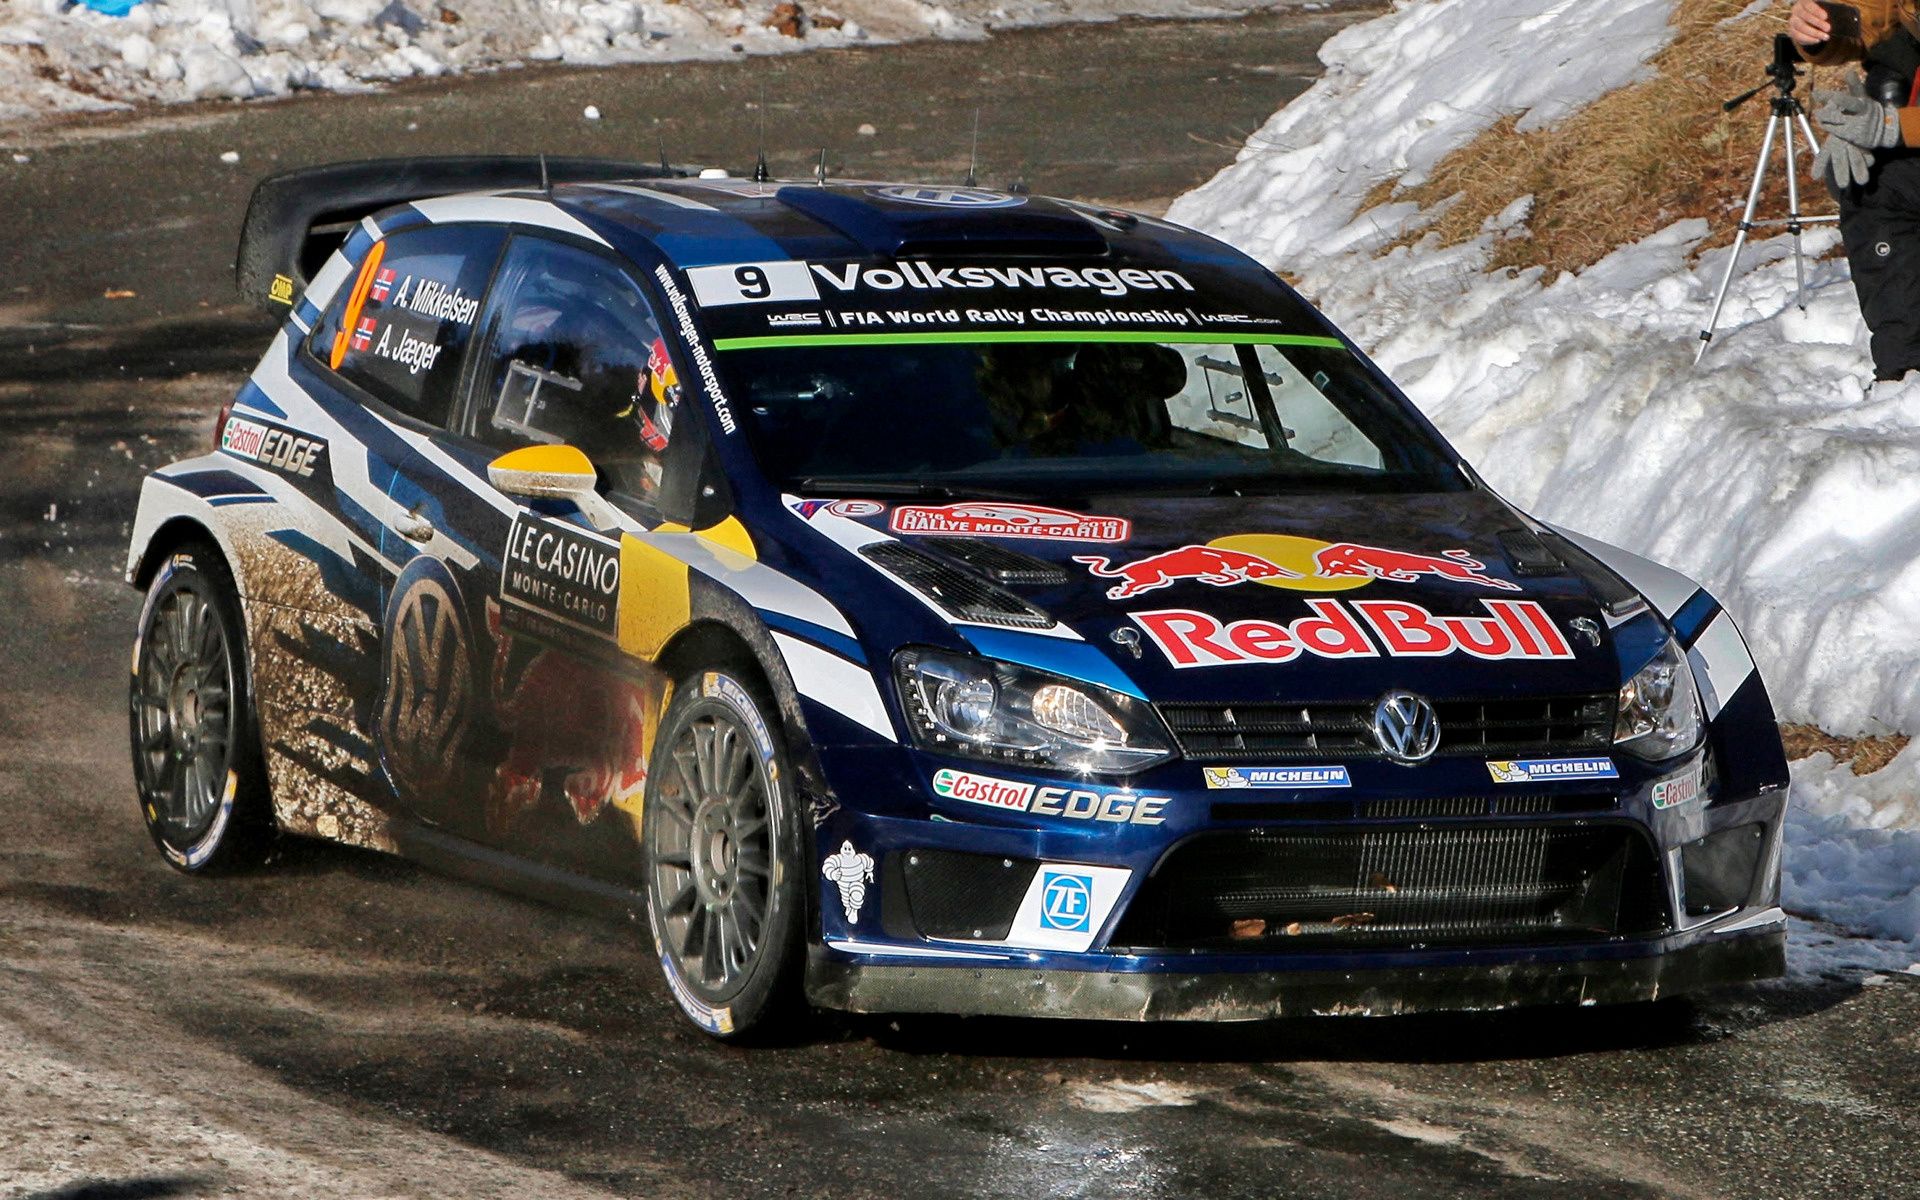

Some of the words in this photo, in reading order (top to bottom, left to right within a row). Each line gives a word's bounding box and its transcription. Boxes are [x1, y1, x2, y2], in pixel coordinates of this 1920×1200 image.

[330, 240, 386, 371] 9
[392, 275, 412, 308] A.
[410, 278, 479, 325] Mikkelsen
[733, 266, 771, 299] 9
[810, 262, 1195, 296] Volkswagen
[840, 311, 885, 325] FIA
[886, 310, 961, 324] World
[967, 309, 1024, 323] Rally
[1030, 308, 1189, 326] Championship
[374, 323, 392, 358] A.
[392, 328, 442, 375] Jæger
[654, 263, 737, 436] www.volkswagen-motorsport.com
[229, 421, 264, 457] Castrol
[258, 429, 325, 477] EDGE
[902, 514, 970, 531] RALLYE
[975, 523, 1118, 539] MONTE-CARLO
[511, 522, 537, 564] LE
[536, 532, 619, 595] CASINO
[1129, 598, 1380, 669] Red
[1349, 598, 1575, 660] Bull
[1250, 770, 1345, 782] MICHELIN
[1529, 761, 1612, 775] MICHELIN
[952, 775, 1025, 809] Castrol
[1029, 786, 1173, 826] EDGE
[1048, 885, 1087, 920] ZF
